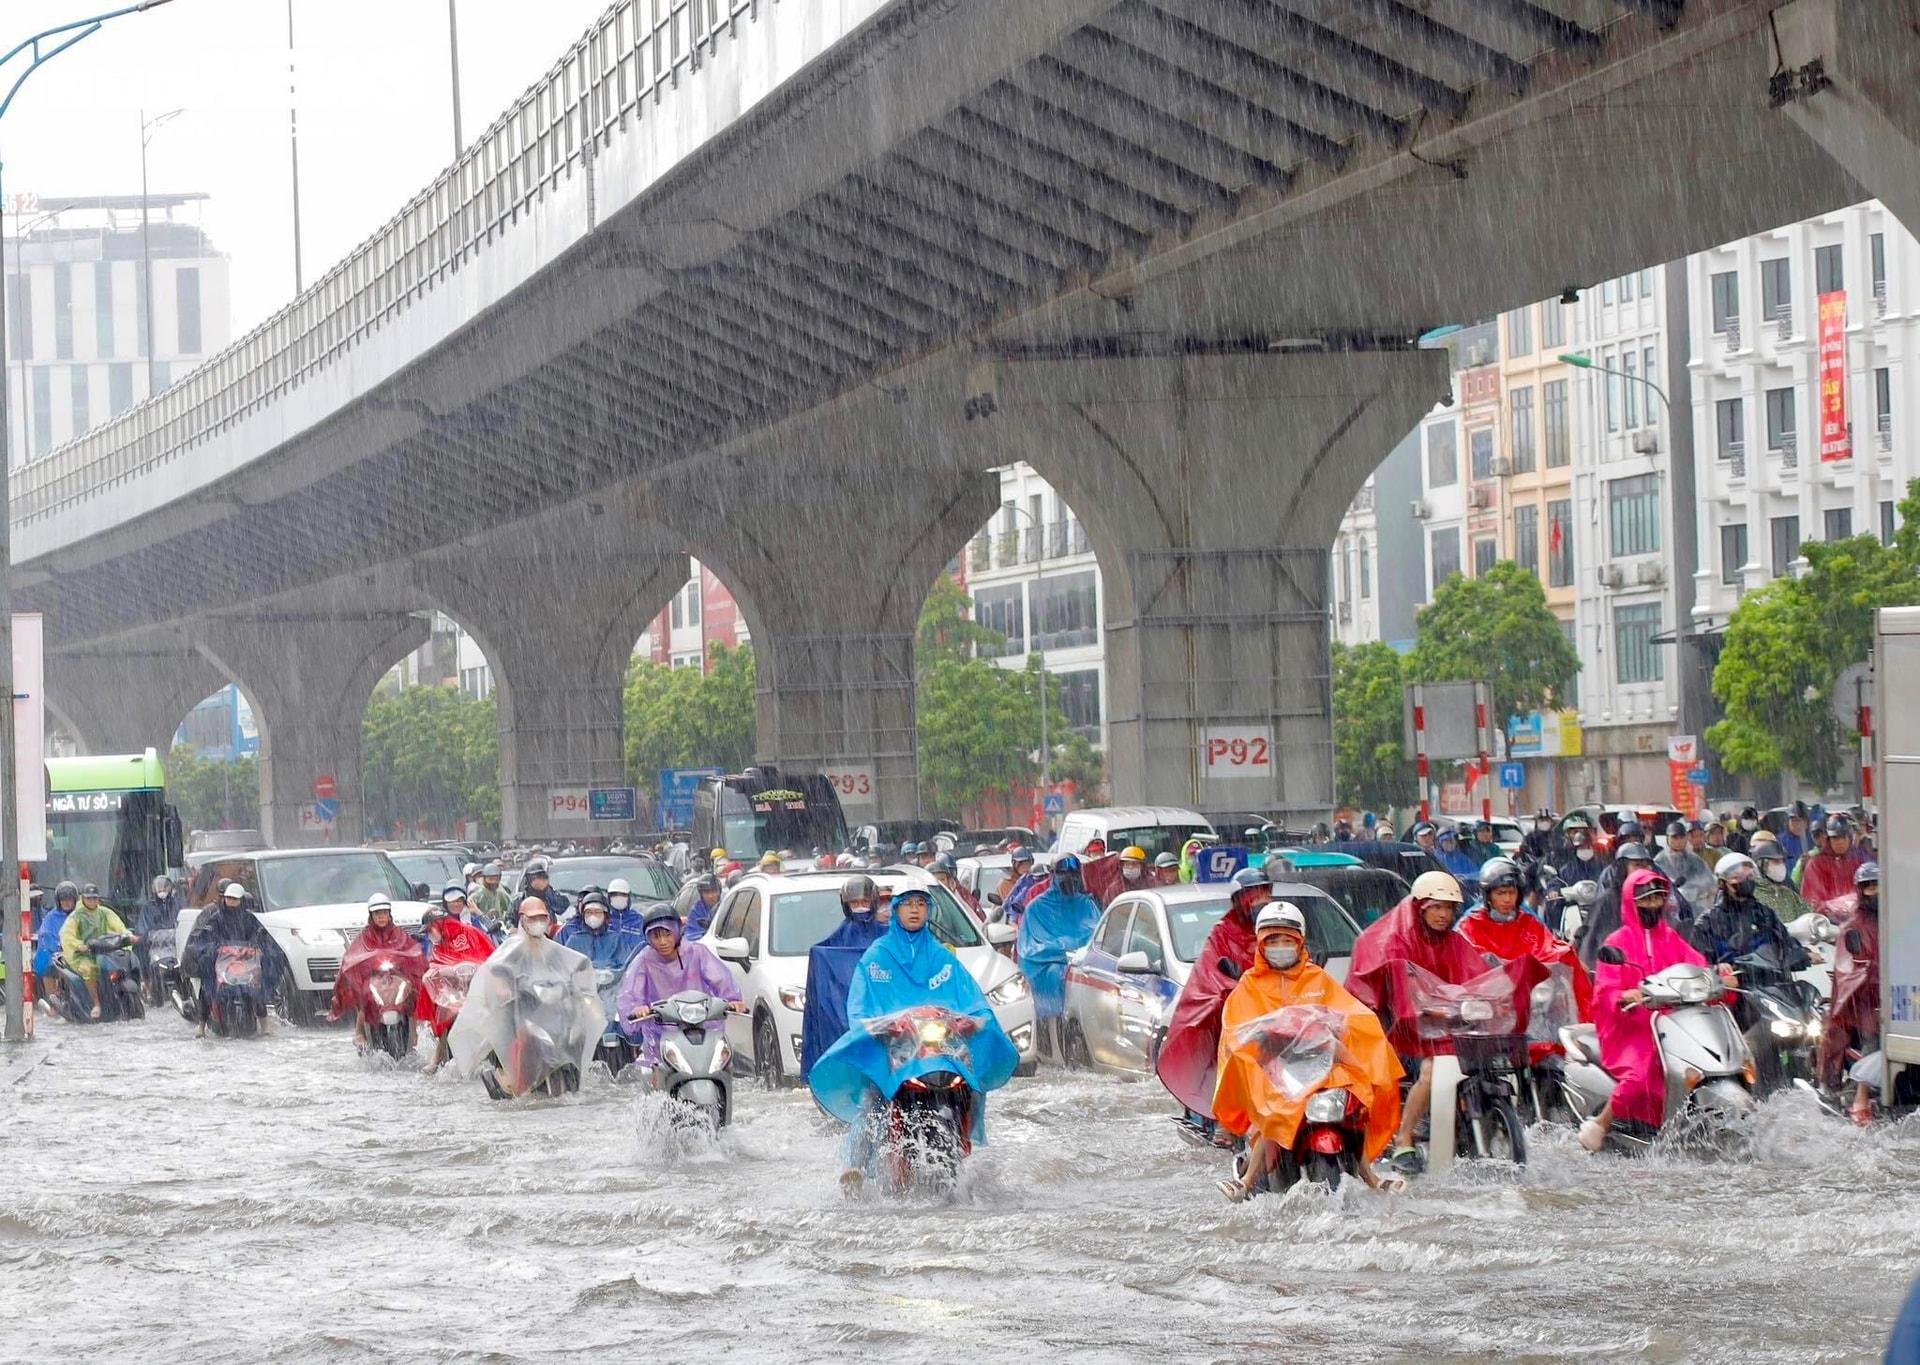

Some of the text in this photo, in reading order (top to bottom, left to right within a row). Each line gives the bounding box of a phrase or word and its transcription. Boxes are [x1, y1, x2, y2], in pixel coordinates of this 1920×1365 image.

[1208, 737, 1268, 766] P92
[53, 794, 75, 811] NGÃ
[77, 794, 91, 810] TƯ
[93, 792, 108, 810] SỞ
[552, 795, 588, 811] P94
